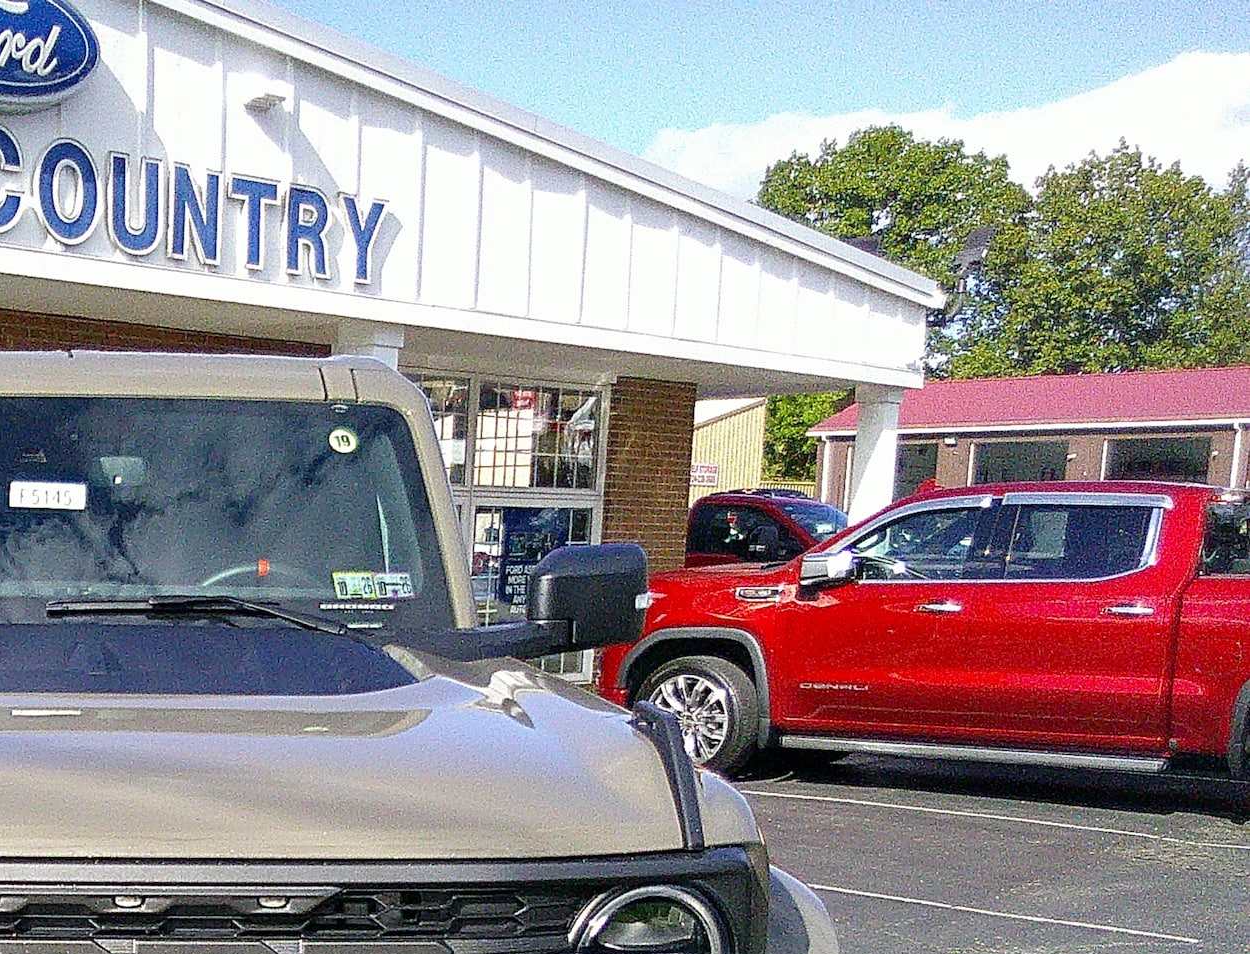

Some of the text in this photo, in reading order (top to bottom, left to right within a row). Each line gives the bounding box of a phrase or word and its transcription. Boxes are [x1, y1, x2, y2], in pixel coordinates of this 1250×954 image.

[333, 434, 351, 448] 19
[19, 488, 73, 506] F5145
[505, 565, 523, 574] FORD
[507, 575, 526, 585] MORE
[505, 585, 526, 595] IN THE
[513, 595, 526, 604] ANY
[799, 682, 869, 691] DENALI
